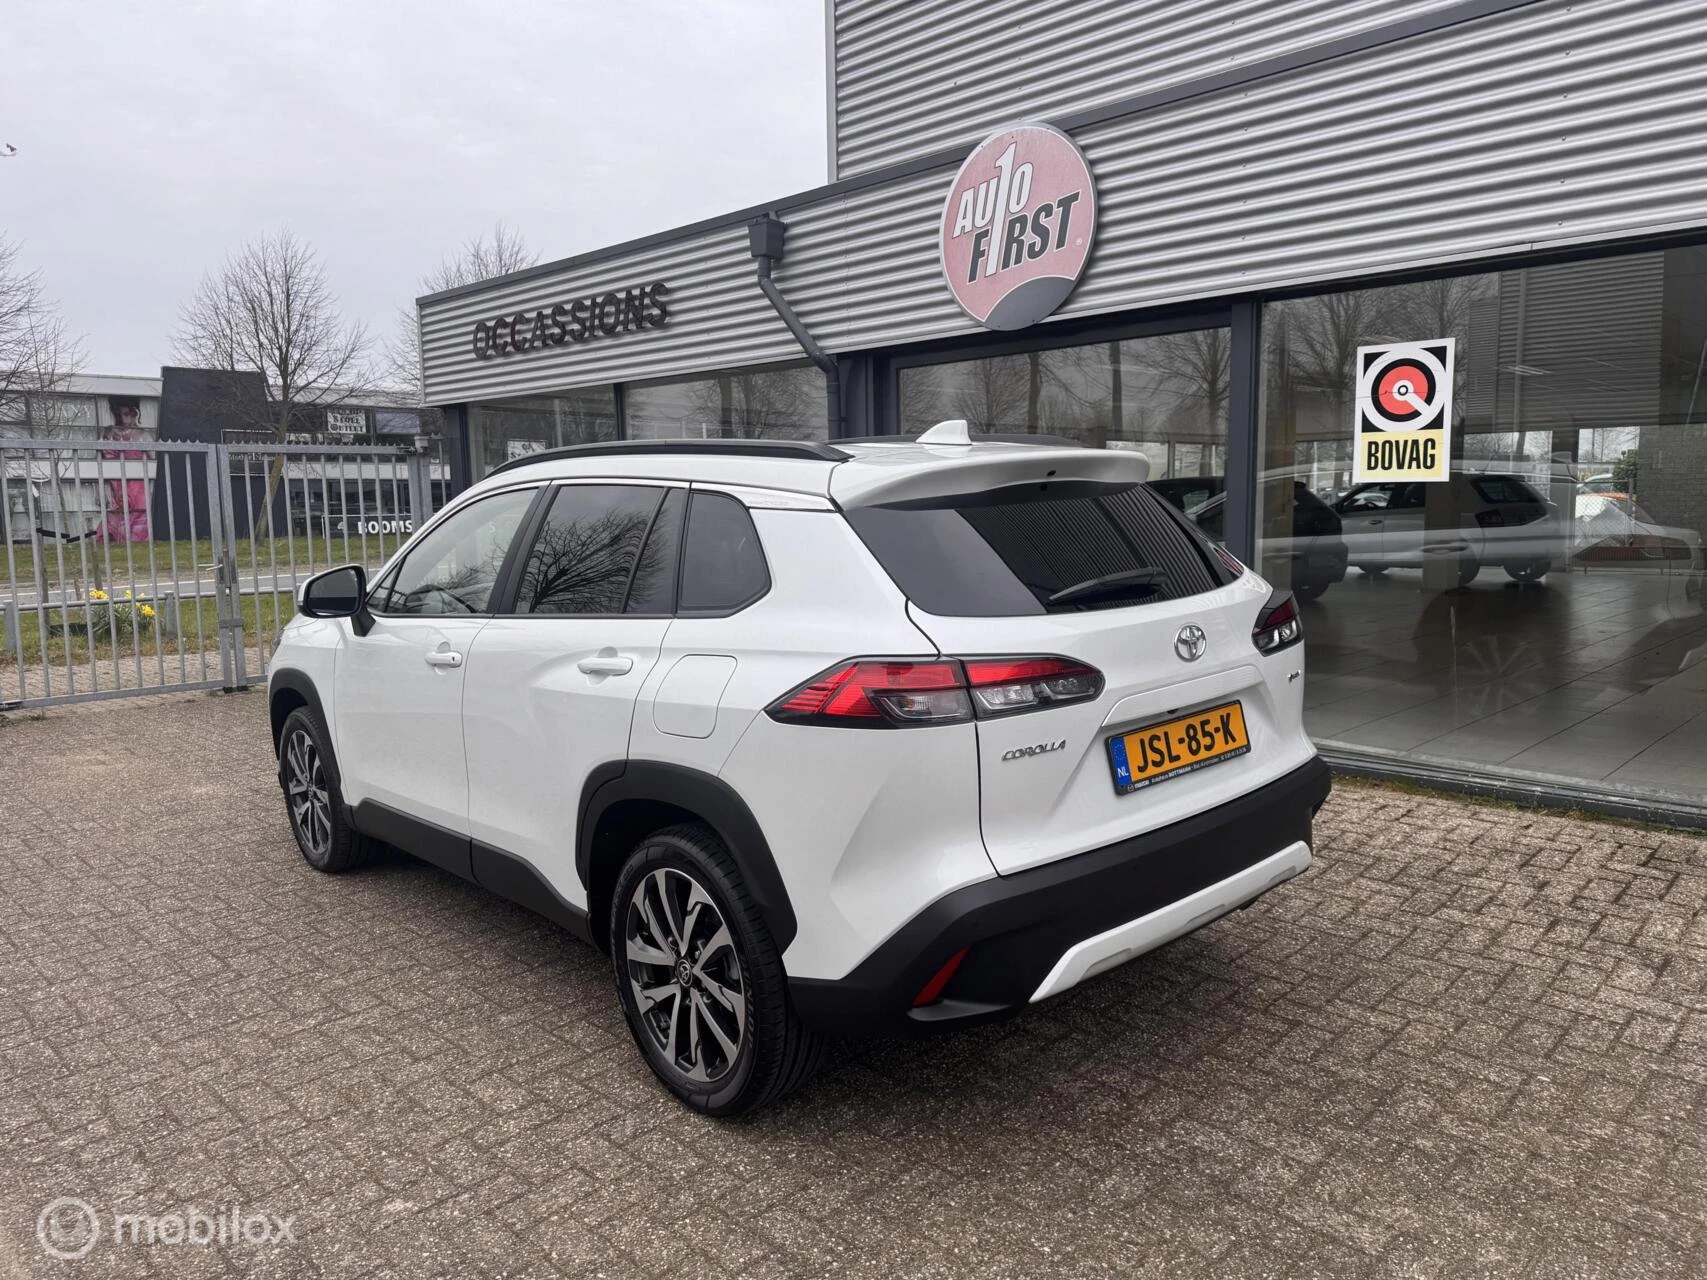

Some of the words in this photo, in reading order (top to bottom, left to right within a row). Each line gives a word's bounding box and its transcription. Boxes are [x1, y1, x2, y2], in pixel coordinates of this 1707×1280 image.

[473, 282, 669, 360] OCCASSIONS
[1366, 438, 1436, 471] BOVAG
[1001, 739, 1066, 761] COROLLA
[1136, 712, 1237, 773] JSL-85-K
[1117, 766, 1130, 778] NL
